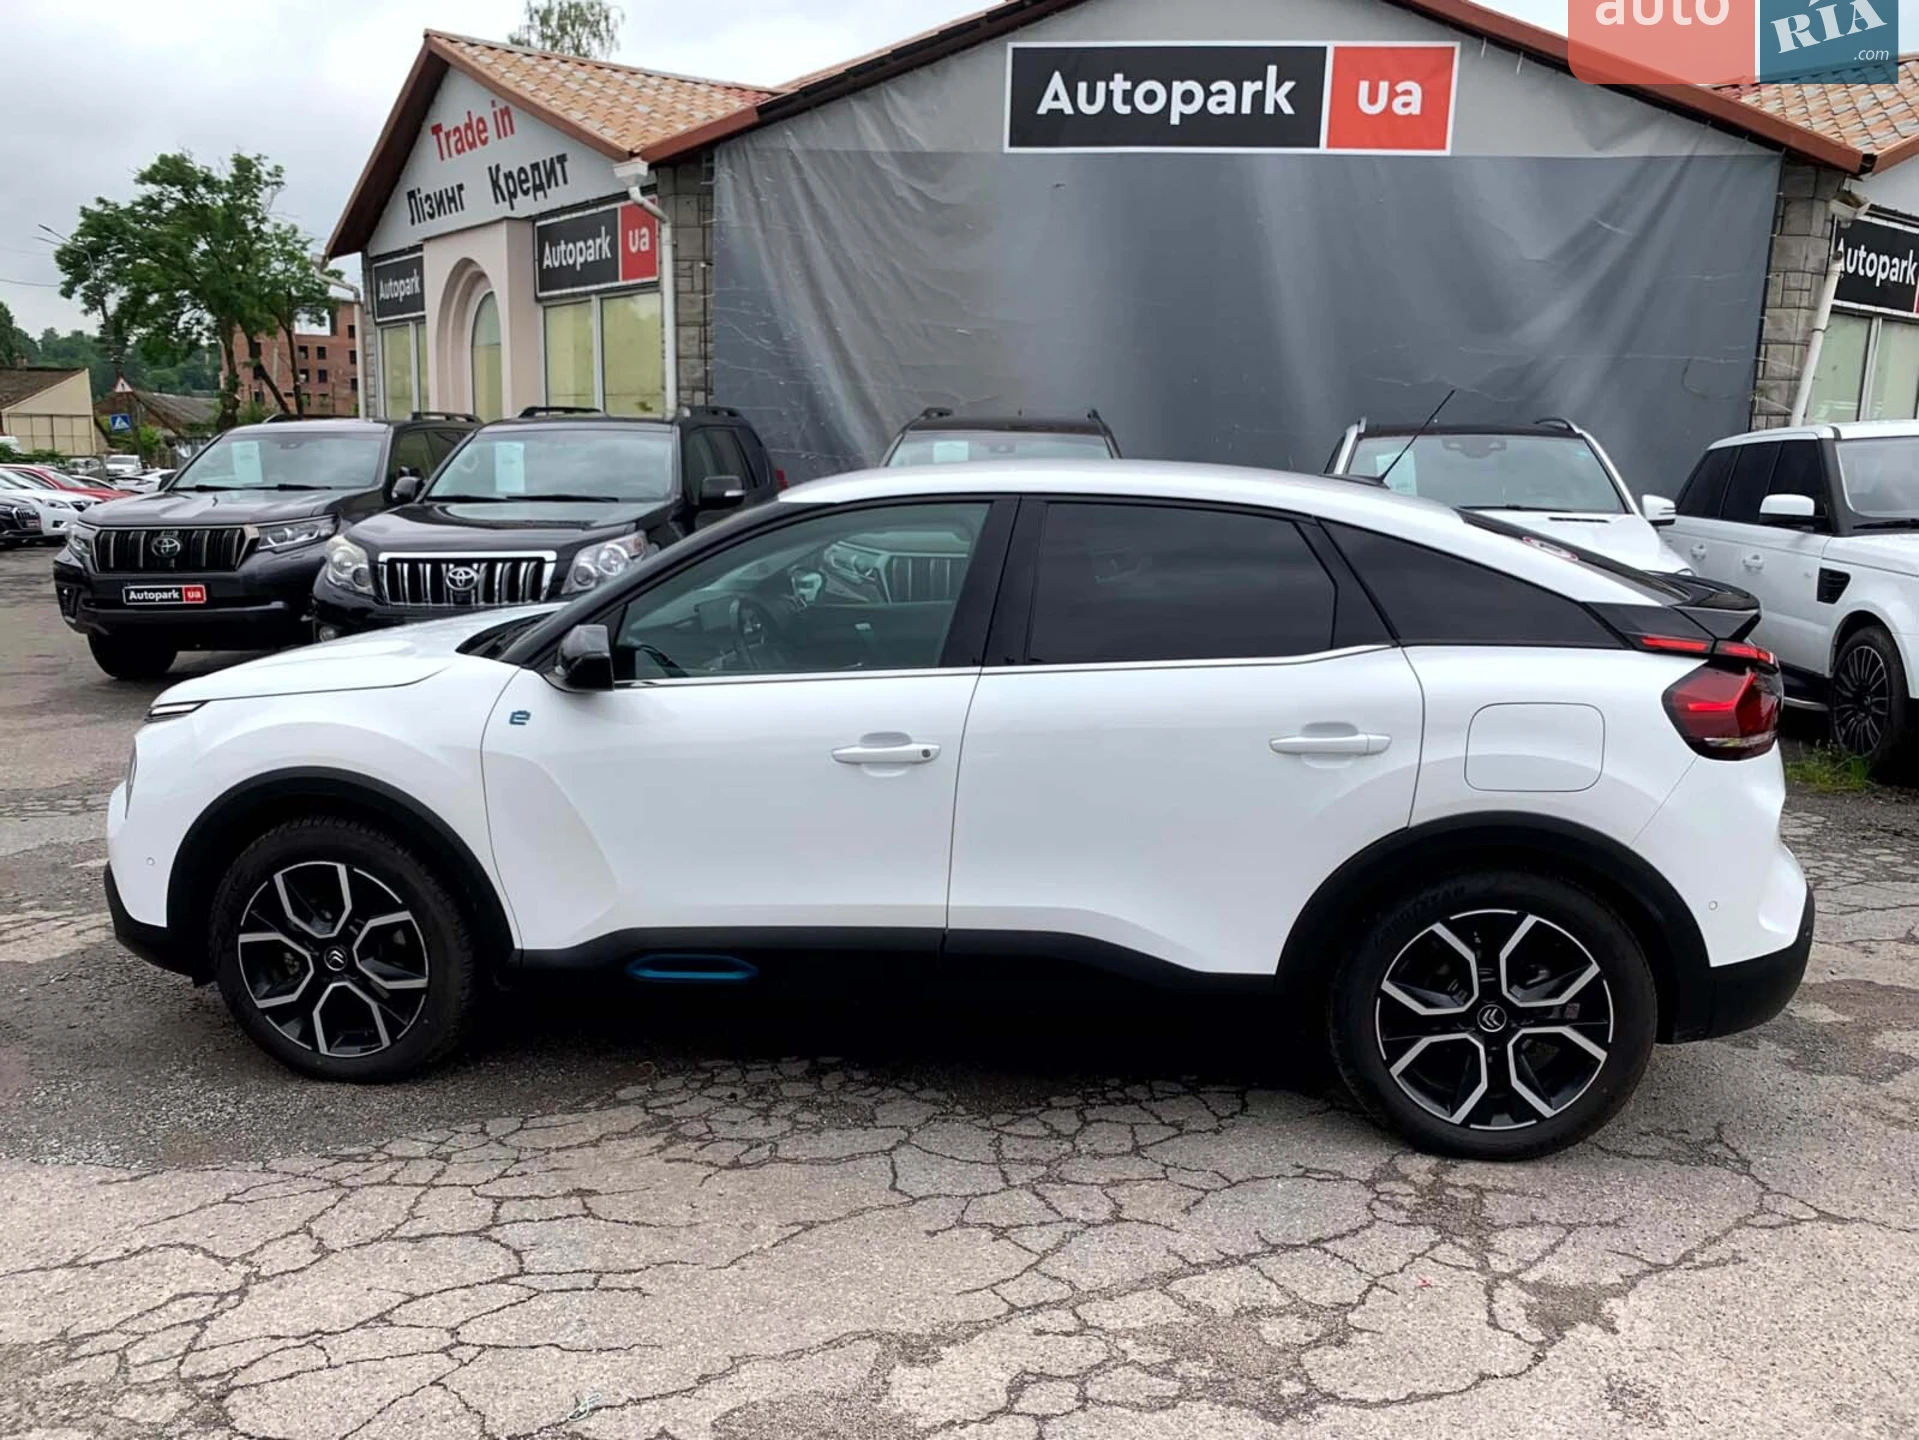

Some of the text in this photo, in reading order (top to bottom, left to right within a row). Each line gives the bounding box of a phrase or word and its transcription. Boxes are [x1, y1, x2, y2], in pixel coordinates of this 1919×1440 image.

[1036, 64, 1423, 126] Autopark ua
[431, 100, 516, 162] Trade in
[406, 181, 465, 227] Лізинг
[488, 153, 569, 210] Кредит
[542, 226, 650, 270] Autopark ua
[378, 268, 422, 303] Autopark
[129, 590, 201, 601] Autopark ua
